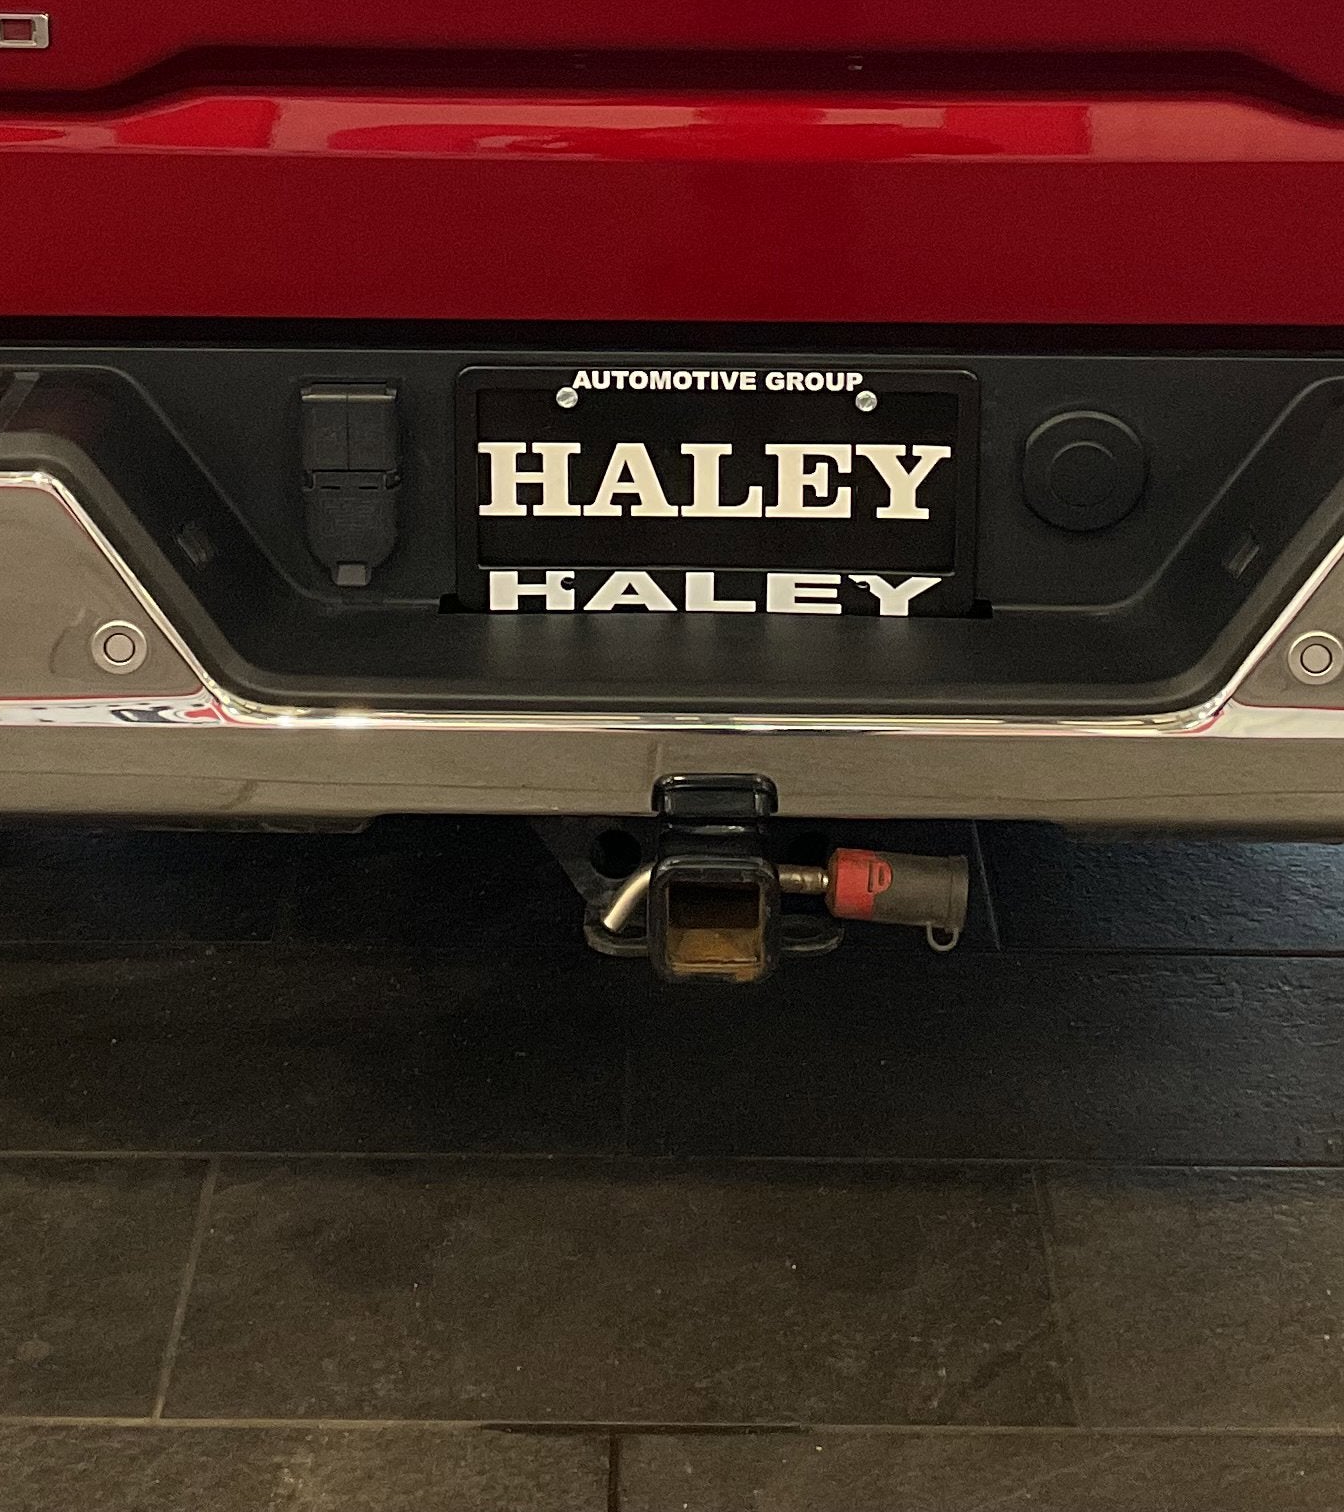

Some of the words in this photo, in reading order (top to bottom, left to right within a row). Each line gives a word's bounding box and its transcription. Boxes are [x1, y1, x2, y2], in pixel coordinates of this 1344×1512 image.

[572, 370, 757, 391] AUTOMOTIVE
[764, 371, 863, 392] GROUP
[478, 442, 951, 519] HALEY
[489, 571, 942, 616] HALEY
